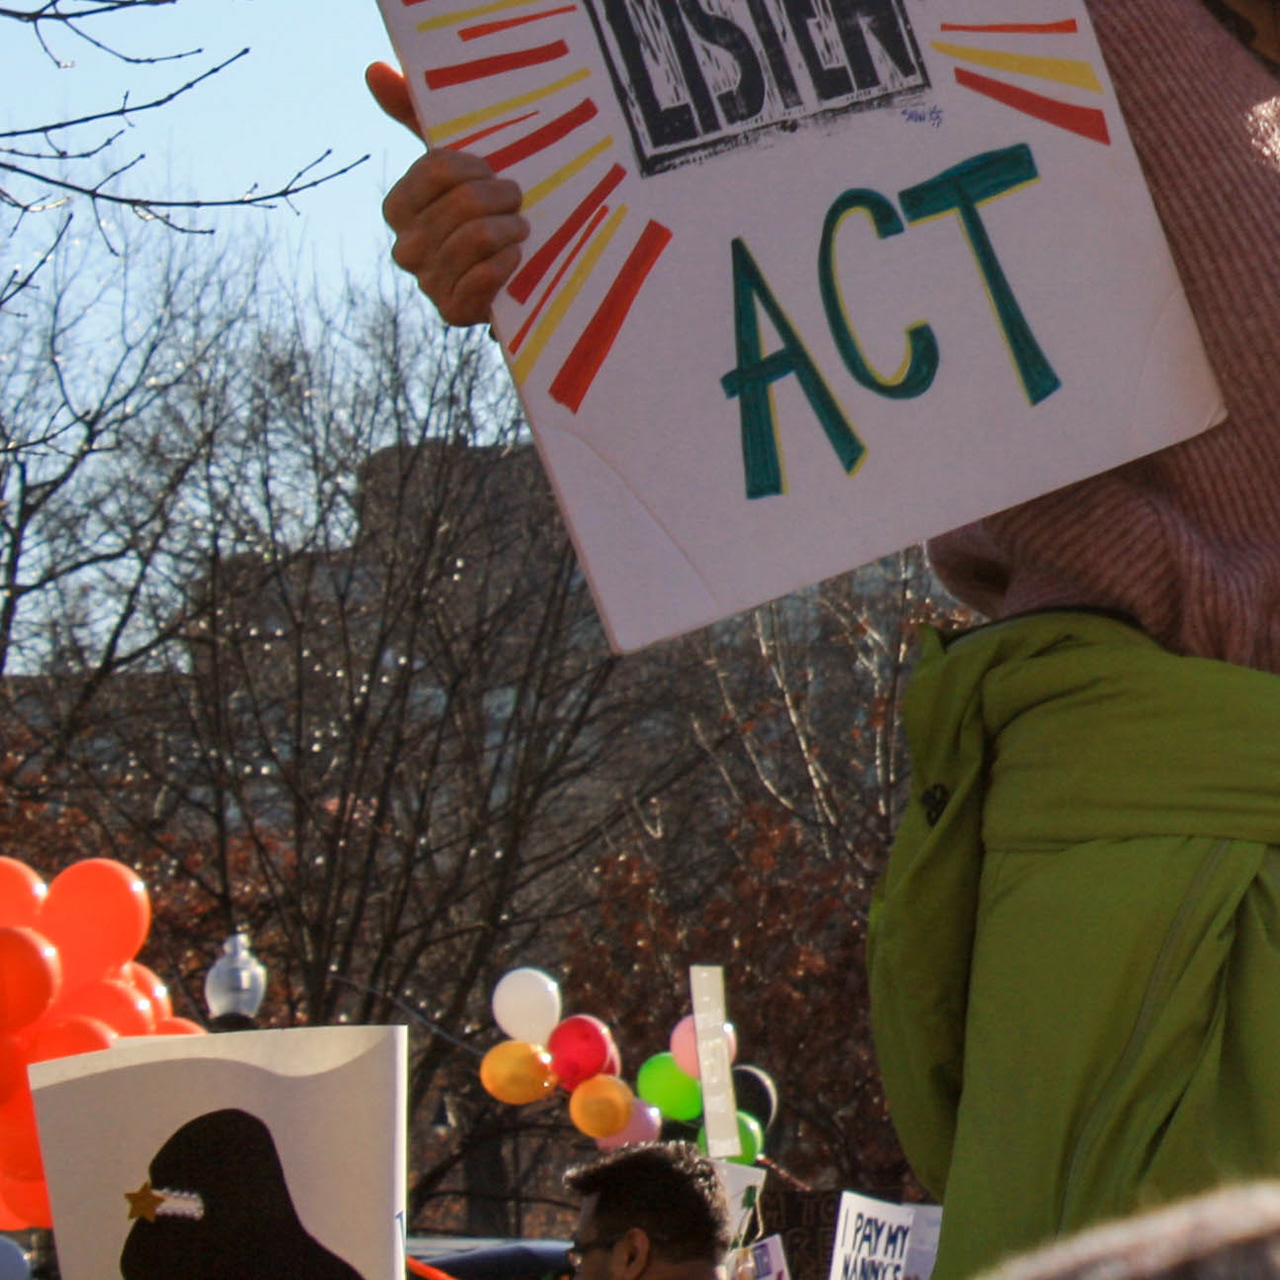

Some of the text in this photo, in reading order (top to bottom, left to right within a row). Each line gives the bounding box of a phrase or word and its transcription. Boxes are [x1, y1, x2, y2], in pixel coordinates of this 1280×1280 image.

[720, 142, 1062, 500] ACT
[852, 1211, 887, 1257] PAY
[883, 1223, 911, 1260] MY
